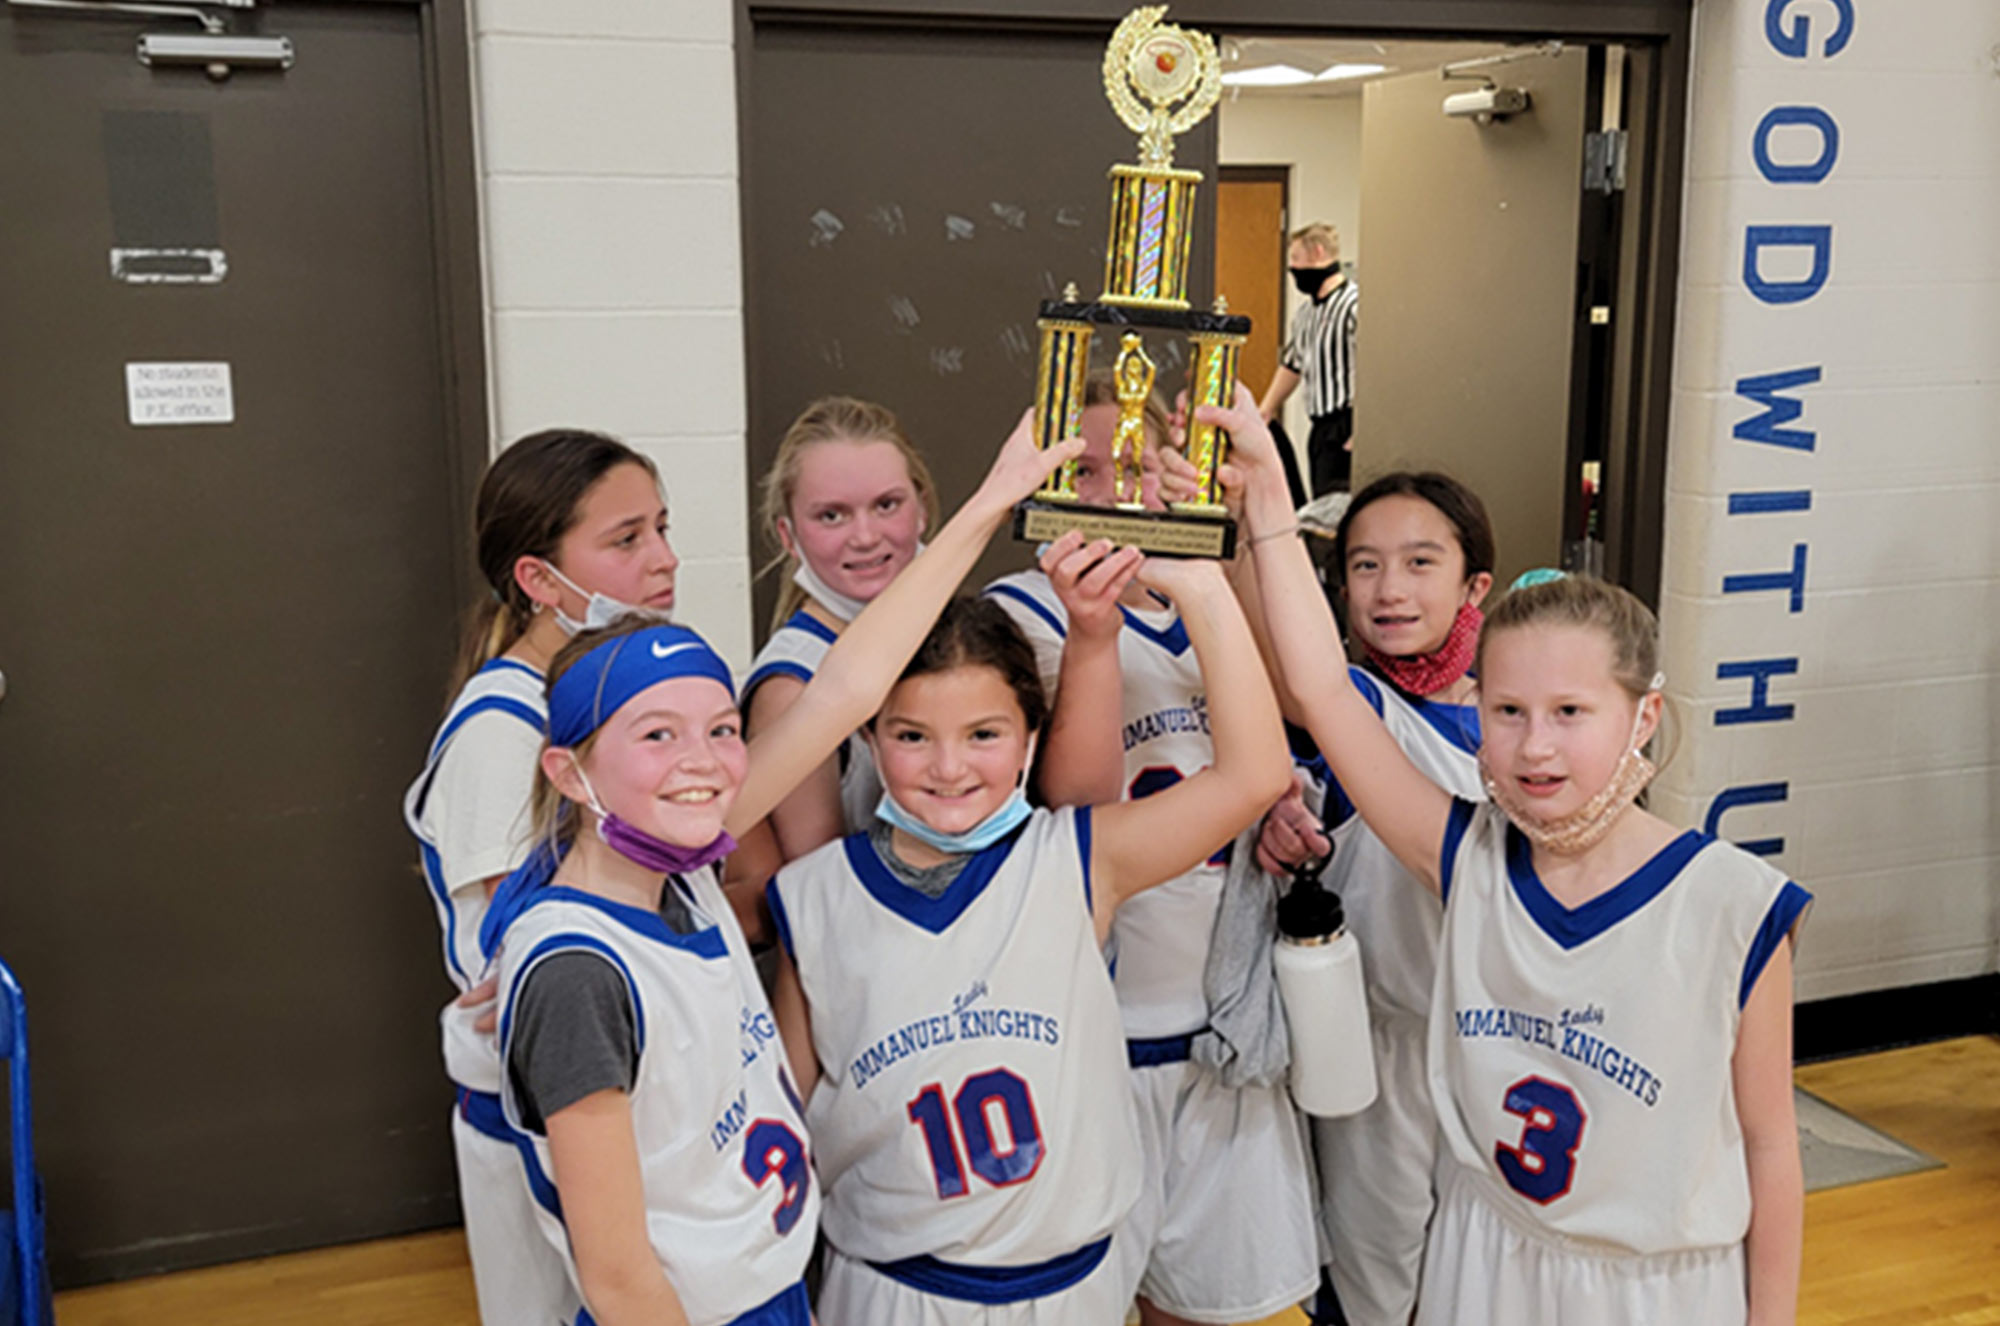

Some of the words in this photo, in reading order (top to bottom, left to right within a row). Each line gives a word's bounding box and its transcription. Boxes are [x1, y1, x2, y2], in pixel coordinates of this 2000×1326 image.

[1742, 0, 1855, 305] GOD
[1713, 365, 1823, 726] WITH
[1703, 781, 1790, 858] U
[850, 1014, 957, 1090] IMMANUEL
[957, 1008, 1060, 1046] KNIGHTS
[953, 980, 988, 1016] Lady
[1558, 1003, 1606, 1029] Lady
[1455, 1008, 1557, 1050] MMANUEL
[1560, 1026, 1663, 1108] KNIGHTS
[741, 1116, 812, 1238] 3
[907, 1066, 1047, 1201] 10
[1493, 1073, 1588, 1207] 3
